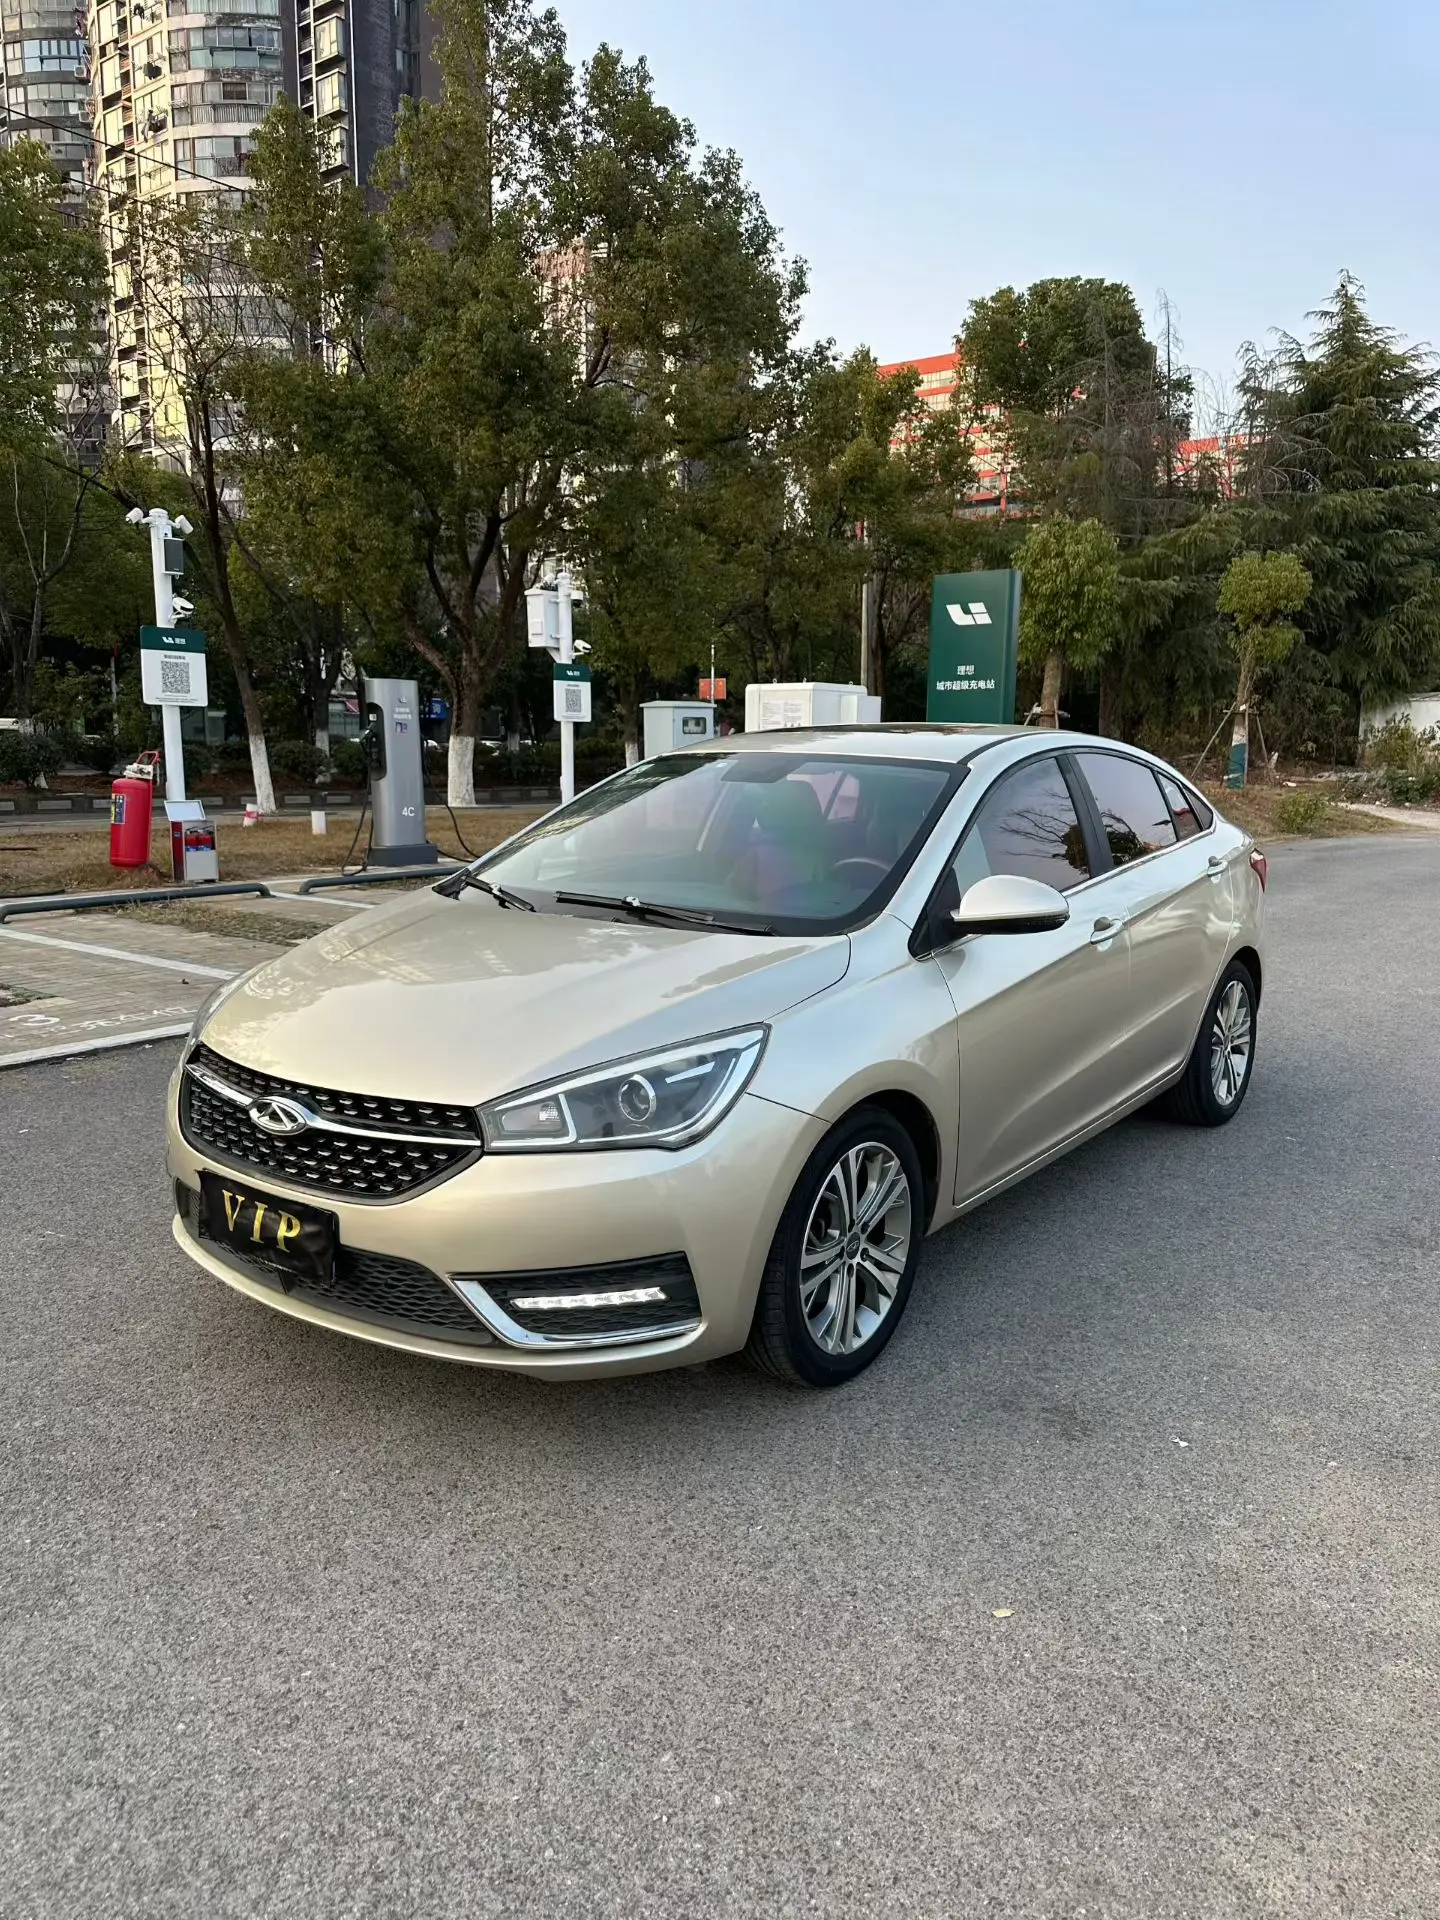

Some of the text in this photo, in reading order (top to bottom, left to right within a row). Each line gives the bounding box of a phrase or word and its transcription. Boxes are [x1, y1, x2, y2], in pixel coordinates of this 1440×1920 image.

[957, 665, 974, 675] 理想
[936, 679, 995, 691] 城市超级充电站
[402, 806, 415, 817] 4C
[222, 1189, 300, 1253] VIP
